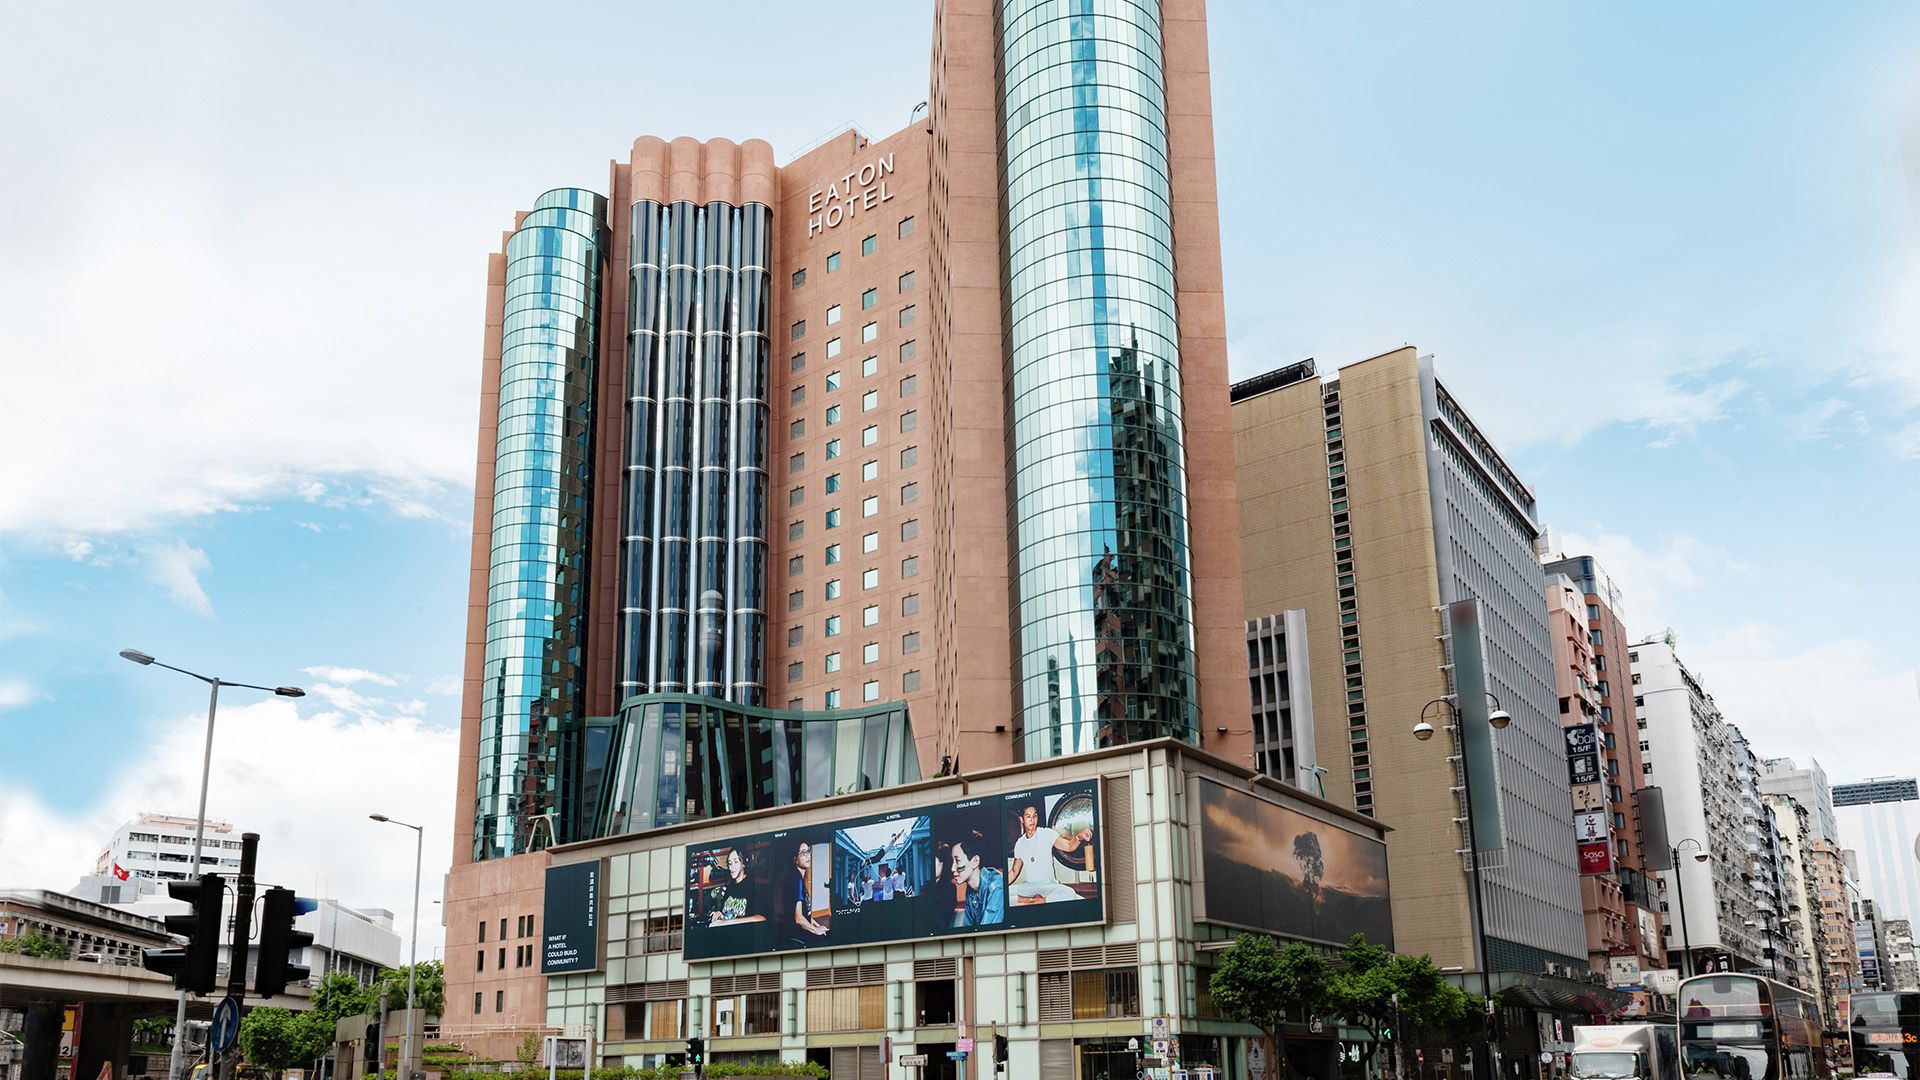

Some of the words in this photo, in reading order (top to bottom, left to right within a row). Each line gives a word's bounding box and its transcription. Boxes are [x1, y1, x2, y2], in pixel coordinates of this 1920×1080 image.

[809, 152, 894, 214] EATON
[808, 181, 894, 239] HOTEL
[1572, 745, 1591, 753] 15/F
[1575, 774, 1595, 783] 15/F
[547, 958, 575, 966] COMMUNITY
[1661, 975, 1675, 983] 128
